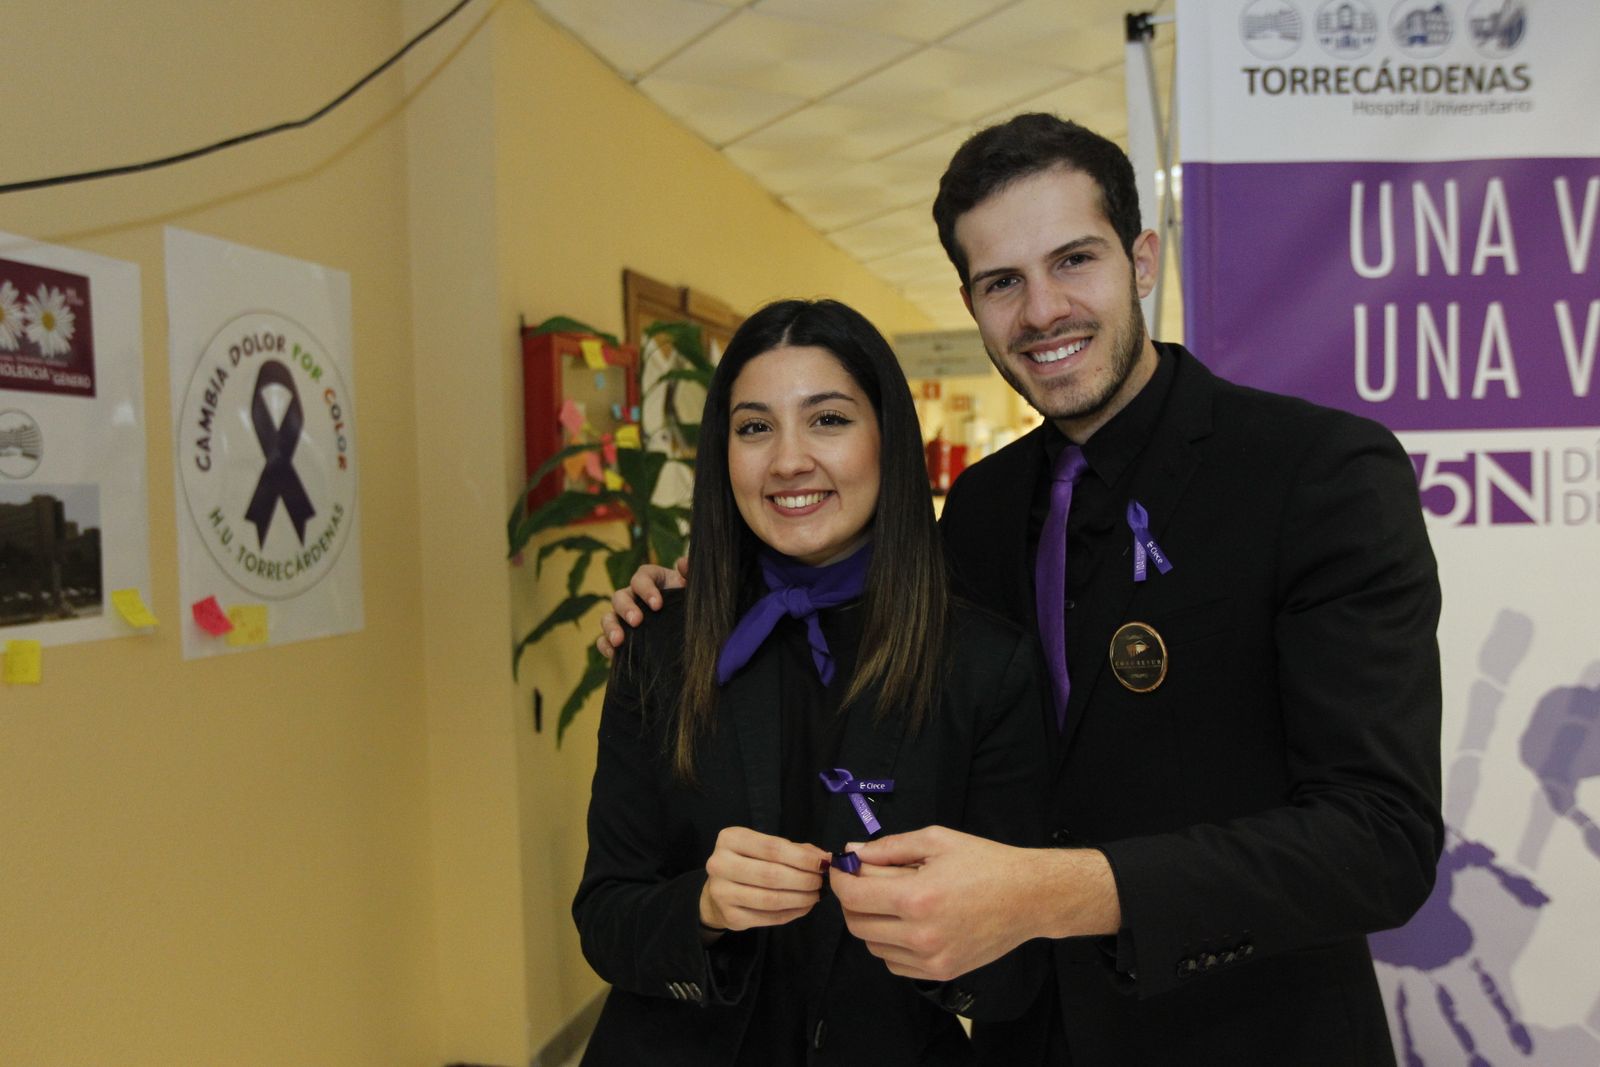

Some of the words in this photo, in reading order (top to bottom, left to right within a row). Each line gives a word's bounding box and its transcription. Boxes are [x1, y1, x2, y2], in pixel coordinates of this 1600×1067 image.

[1242, 58, 1532, 96] TORRECÁRDENAS
[1352, 100, 1419, 116] Hospital
[1425, 99, 1532, 115] Universitario
[1350, 178, 1519, 279] UNA
[195, 366, 229, 472] CAMBIA
[229, 332, 285, 367] DOLOR
[292, 343, 323, 380] POR
[324, 387, 347, 471] COLOR
[1352, 302, 1520, 402] UNA
